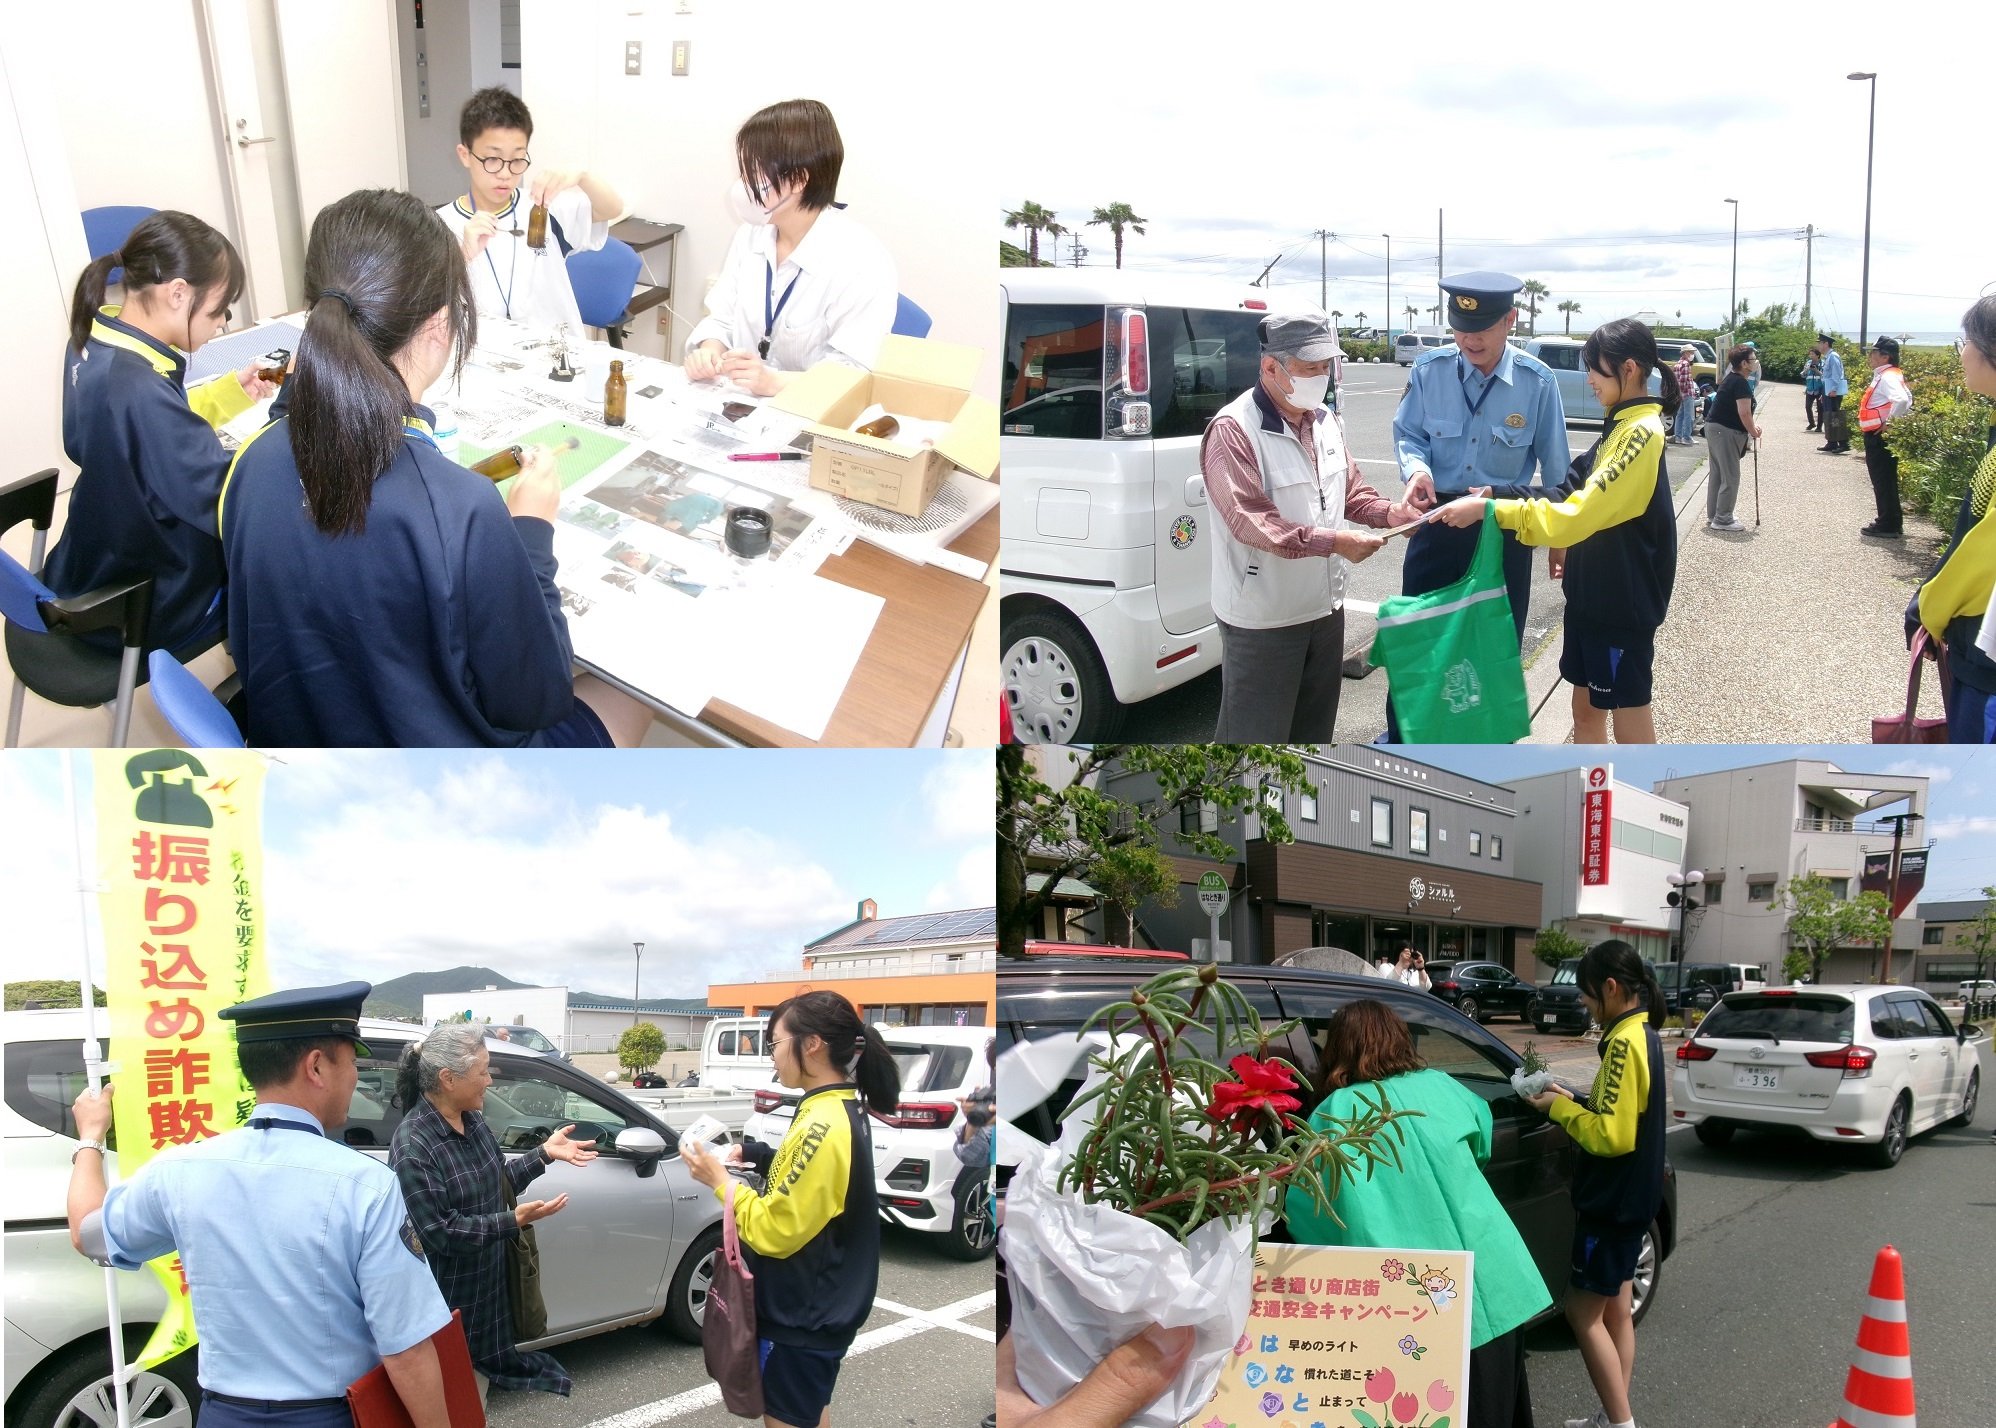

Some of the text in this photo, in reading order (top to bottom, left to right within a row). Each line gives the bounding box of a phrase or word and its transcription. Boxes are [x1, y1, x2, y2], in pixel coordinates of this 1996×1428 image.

[1594, 424, 1654, 493] TAHARA
[1588, 793, 1603, 883] 東海東京証券
[1203, 875, 1221, 887] BUS
[1200, 892, 1226, 903] はなとき通り
[132, 830, 219, 1151] 振り込め詐欺
[1601, 1038, 1630, 1115] TAHARA
[777, 1122, 831, 1196] TAHARA
[1249, 1299, 1428, 1322] 交通安全キャンペーン
[1260, 1334, 1358, 1353] は 早めのライト
[1274, 1364, 1375, 1384] な 慣れた道こそ
[1292, 1392, 1367, 1412] と 止まって
